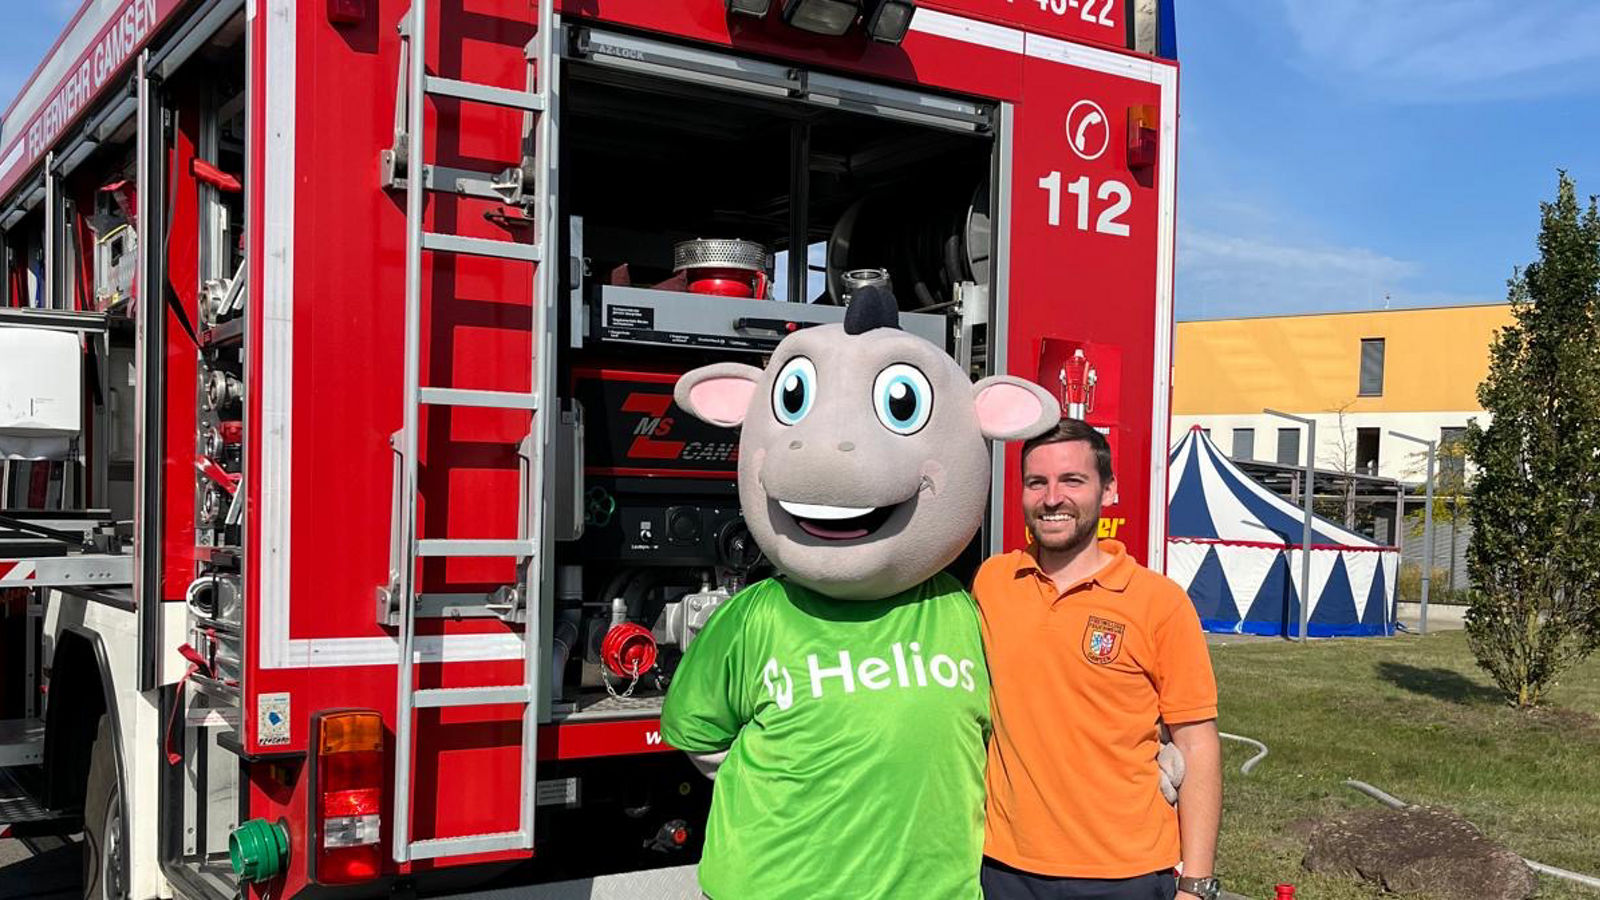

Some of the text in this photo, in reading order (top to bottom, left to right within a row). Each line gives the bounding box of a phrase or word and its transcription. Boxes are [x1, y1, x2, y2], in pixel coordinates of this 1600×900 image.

[29, 0, 157, 165] FEUERWEHR GAMSEN
[1038, 171, 1132, 237] 112
[807, 641, 975, 699] Helios
